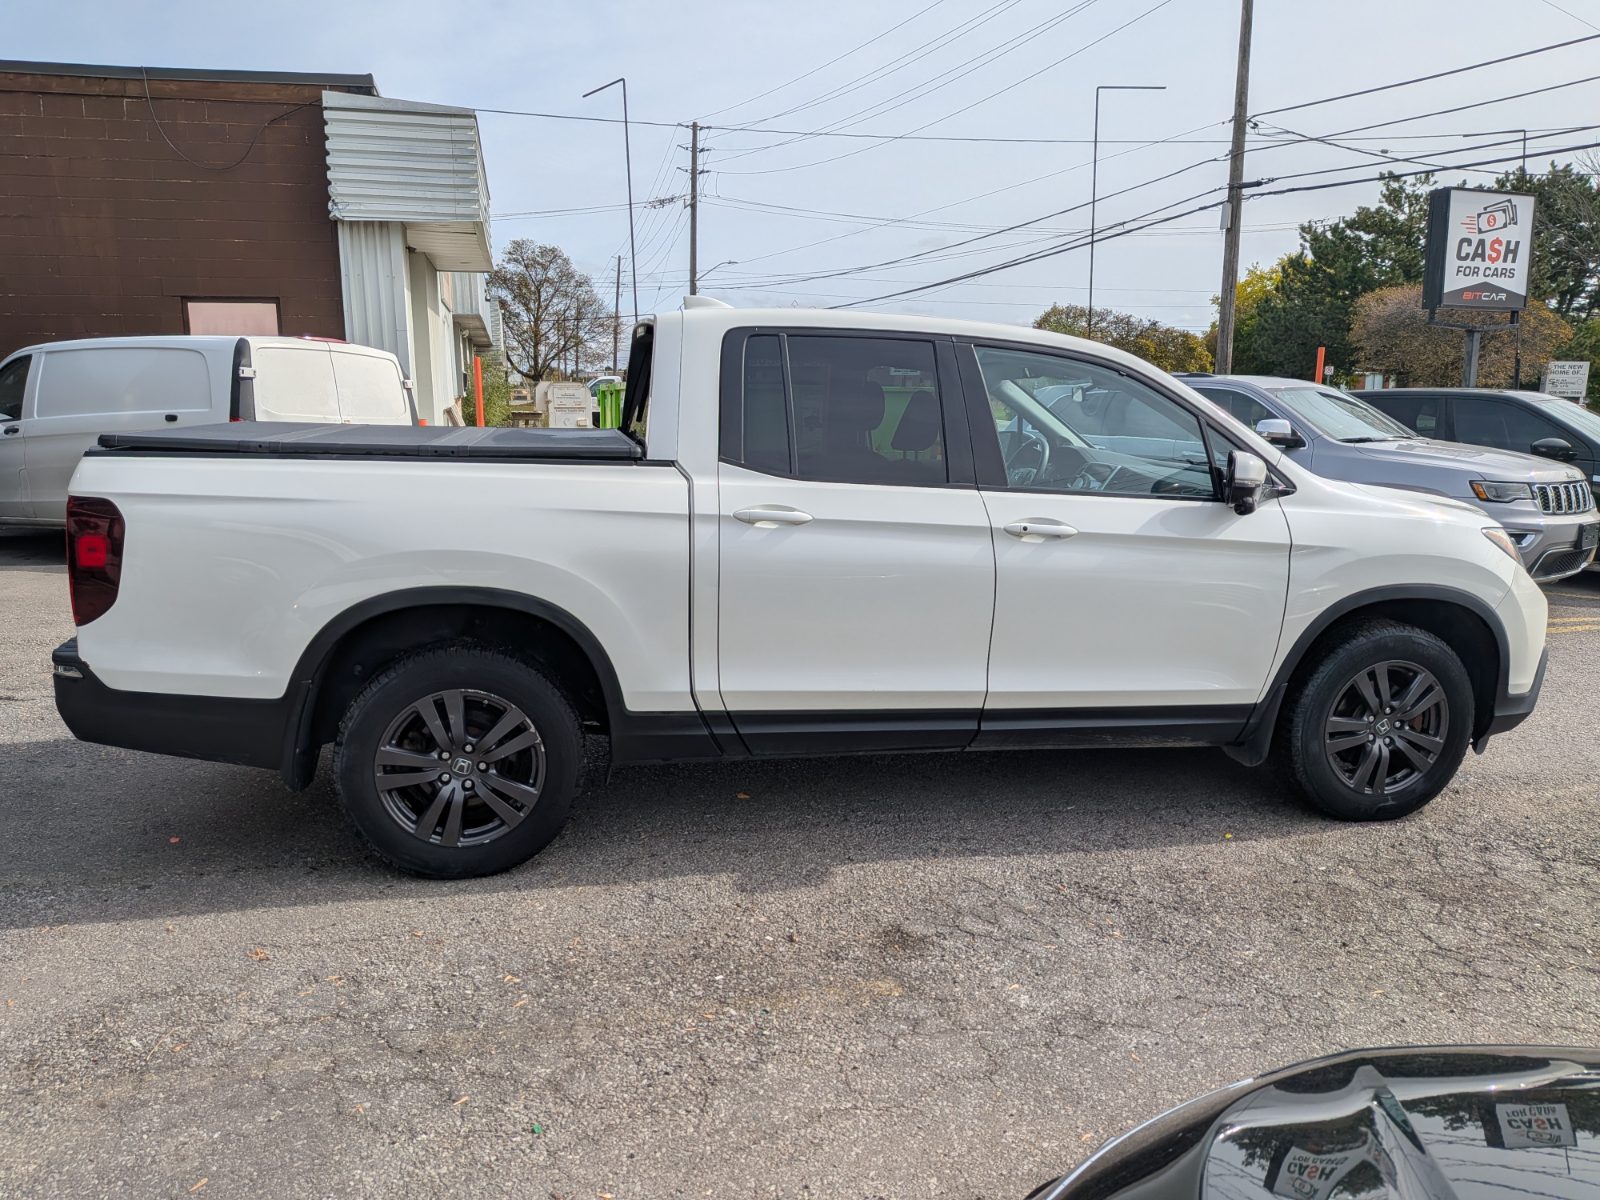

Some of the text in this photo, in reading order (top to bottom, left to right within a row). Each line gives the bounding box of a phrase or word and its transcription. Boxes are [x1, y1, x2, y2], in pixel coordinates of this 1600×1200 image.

[1456, 237, 1520, 264] CA$H
[1456, 266, 1516, 279] FOR CARS
[1462, 292, 1507, 302] BITCAR
